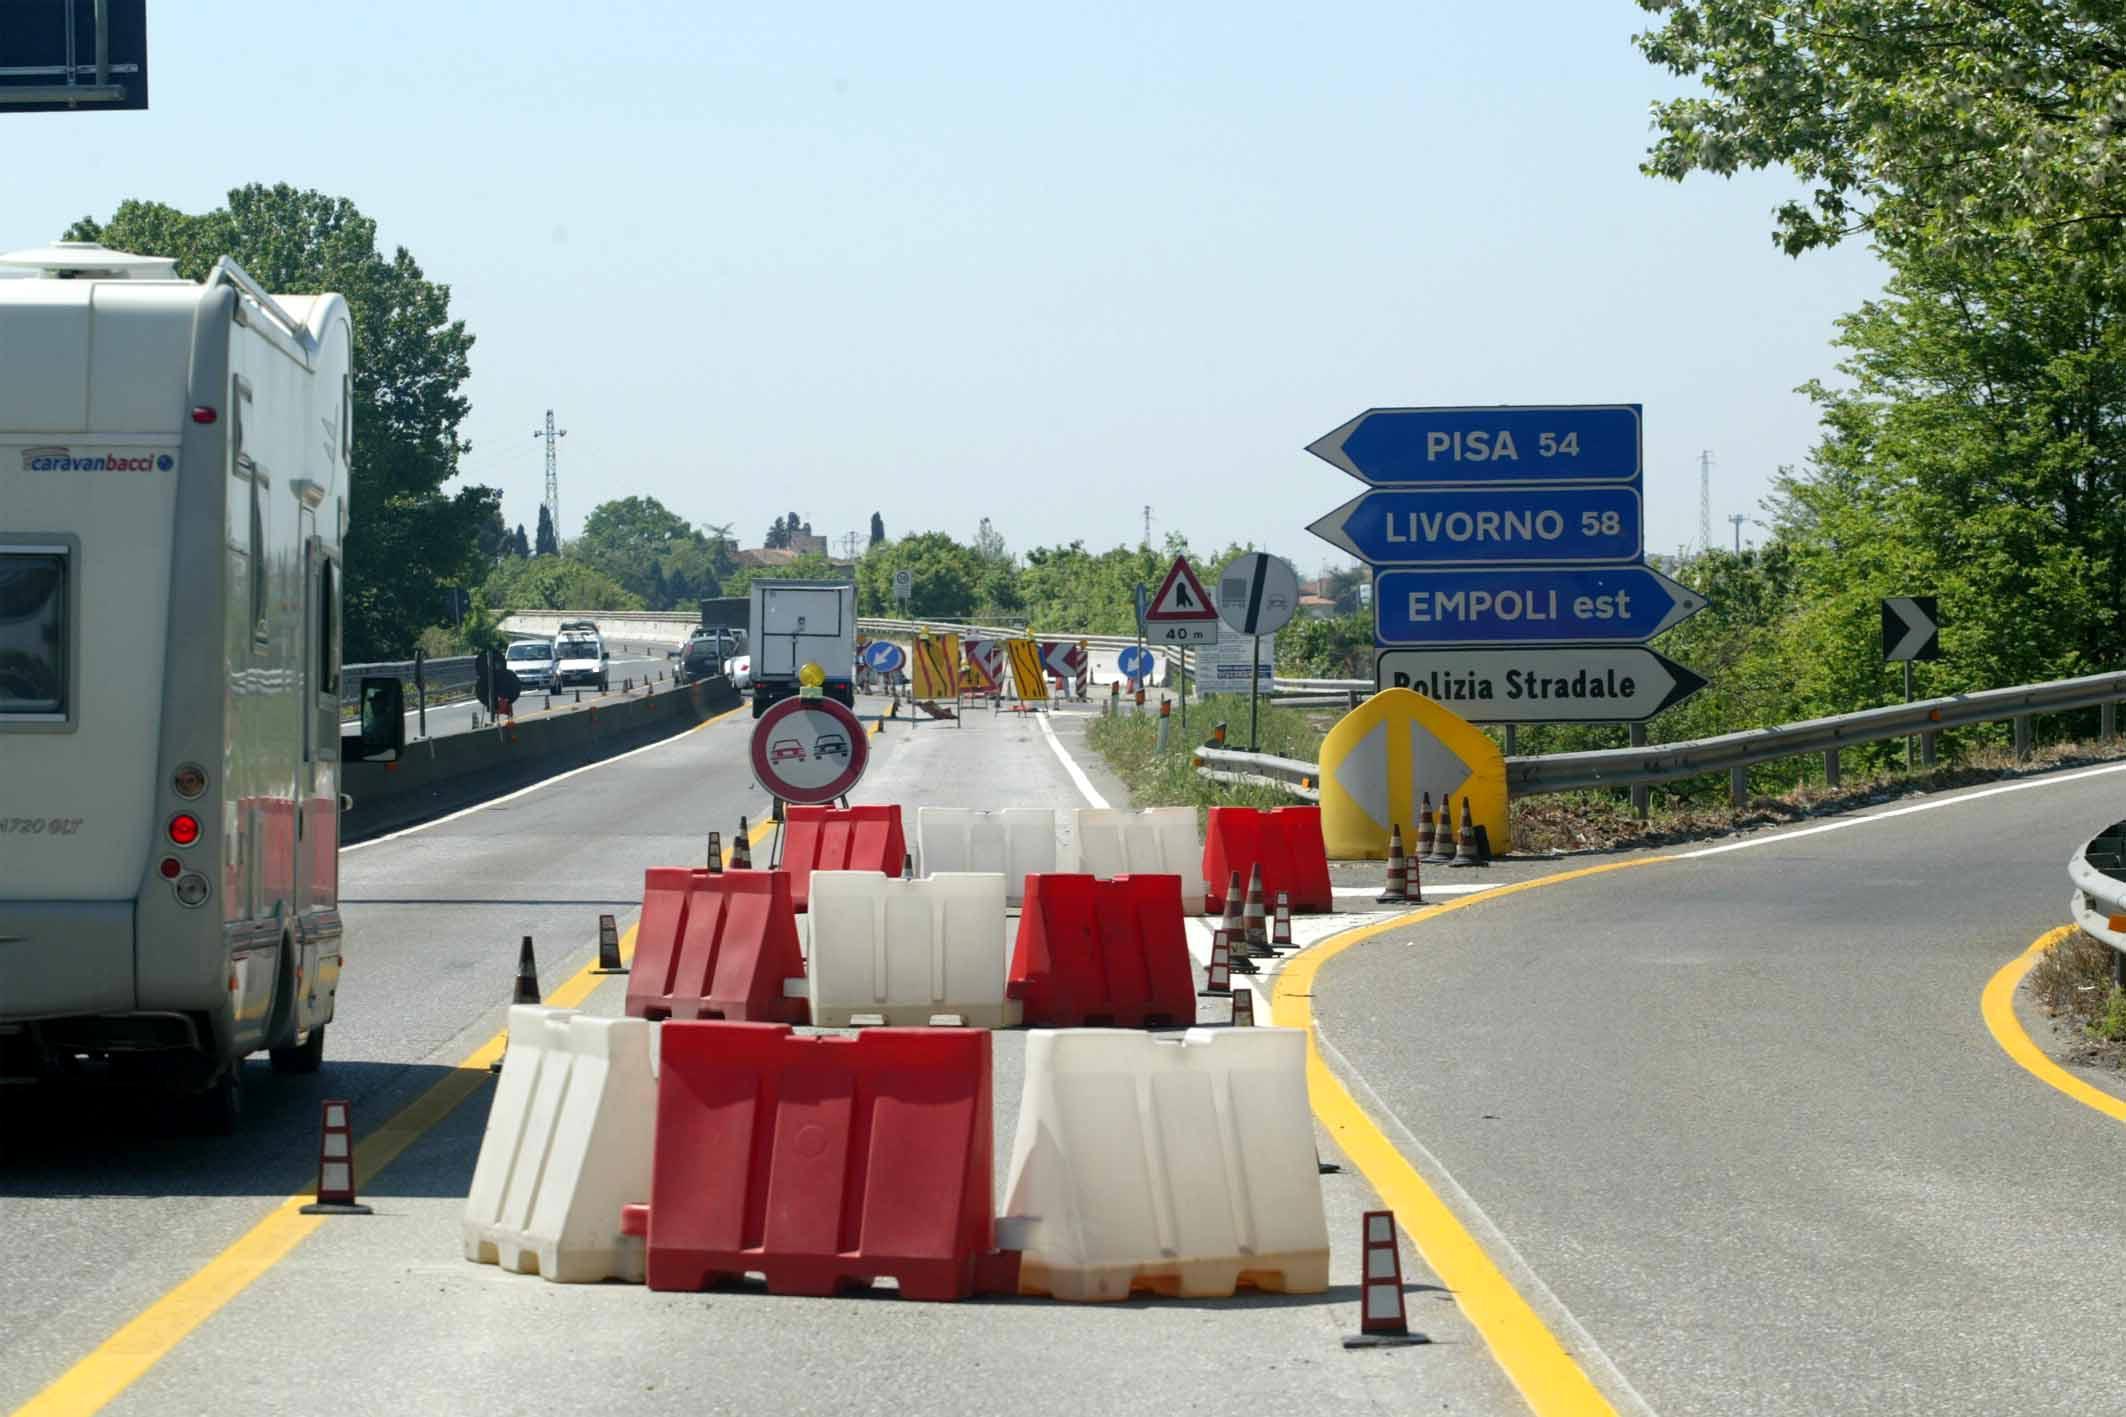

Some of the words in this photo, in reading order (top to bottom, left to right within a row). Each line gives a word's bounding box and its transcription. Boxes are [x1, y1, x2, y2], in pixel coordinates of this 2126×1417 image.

[1426, 430, 1519, 461] PISA
[1539, 431, 1580, 457] 54
[31, 453, 154, 471] caravanbacci
[1386, 510, 1564, 542] LIVORNO
[1581, 511, 1620, 536] 58
[1408, 590, 1557, 621] EMPOLI
[1573, 589, 1632, 619] est
[1165, 628, 1188, 639] 40
[1394, 671, 1493, 700] Polizia
[1506, 669, 1636, 700] Stradale
